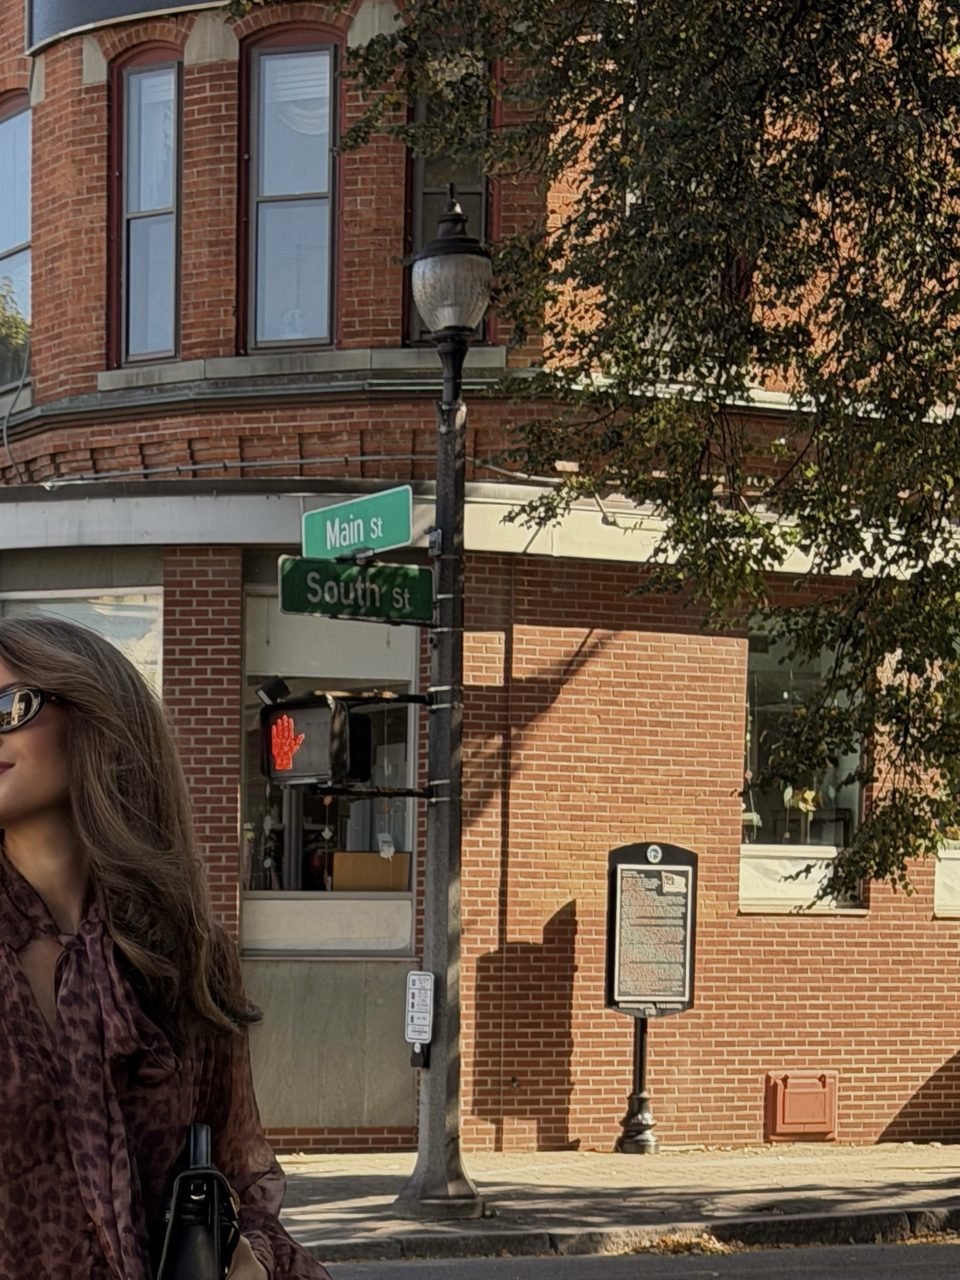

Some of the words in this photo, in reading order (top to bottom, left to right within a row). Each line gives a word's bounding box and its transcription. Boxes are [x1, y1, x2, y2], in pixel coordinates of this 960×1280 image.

[326, 514, 364, 550] Main
[370, 517, 383, 539] St
[306, 571, 381, 607] South
[392, 587, 410, 609] St
